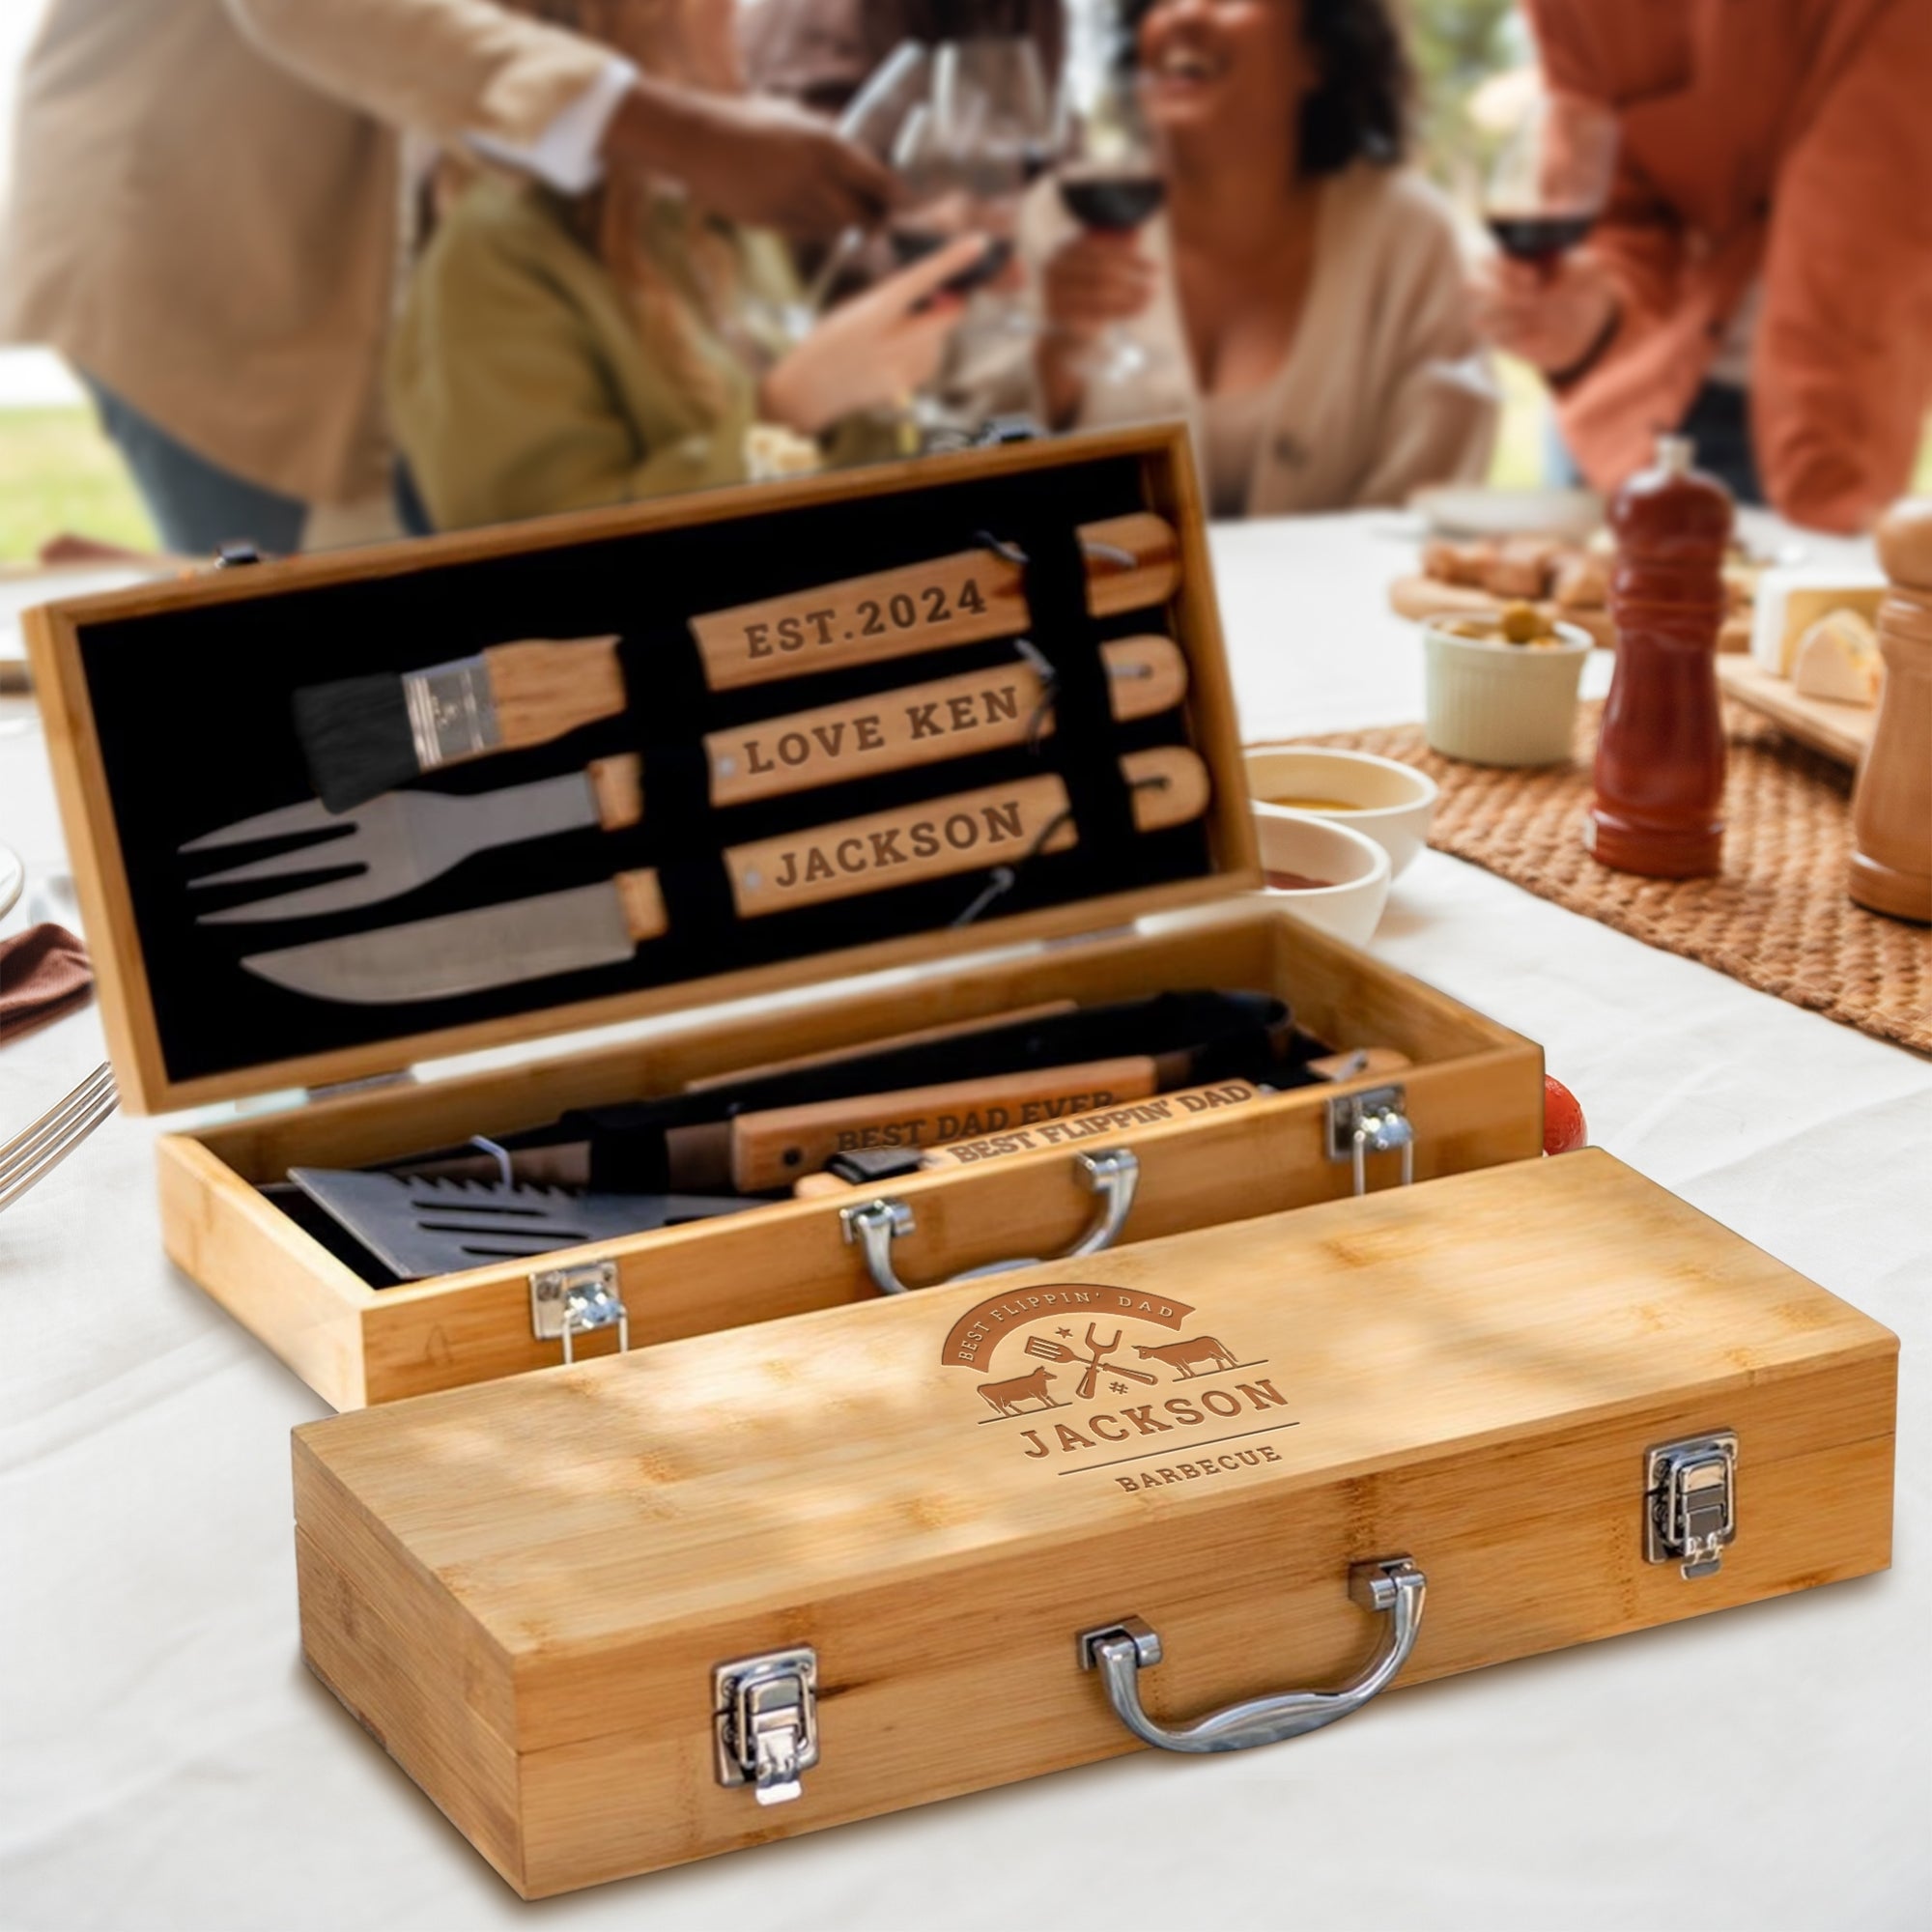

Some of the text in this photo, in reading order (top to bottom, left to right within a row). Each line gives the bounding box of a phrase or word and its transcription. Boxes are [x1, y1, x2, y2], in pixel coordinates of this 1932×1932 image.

[744, 579, 986, 659] EST.2024
[743, 686, 1019, 775] LOVE KEN
[775, 802, 1024, 888] JACKSON
[837, 1119, 926, 1152] BEST
[936, 1107, 1009, 1142] DAD
[946, 1083, 1253, 1165] BEST FLIPPIN' DAD
[958, 1291, 1175, 1363] BEST FLIPPIN' DAD
[1019, 1378, 1290, 1459] JACKSON
[1114, 1445, 1284, 1493] BARBECUE
